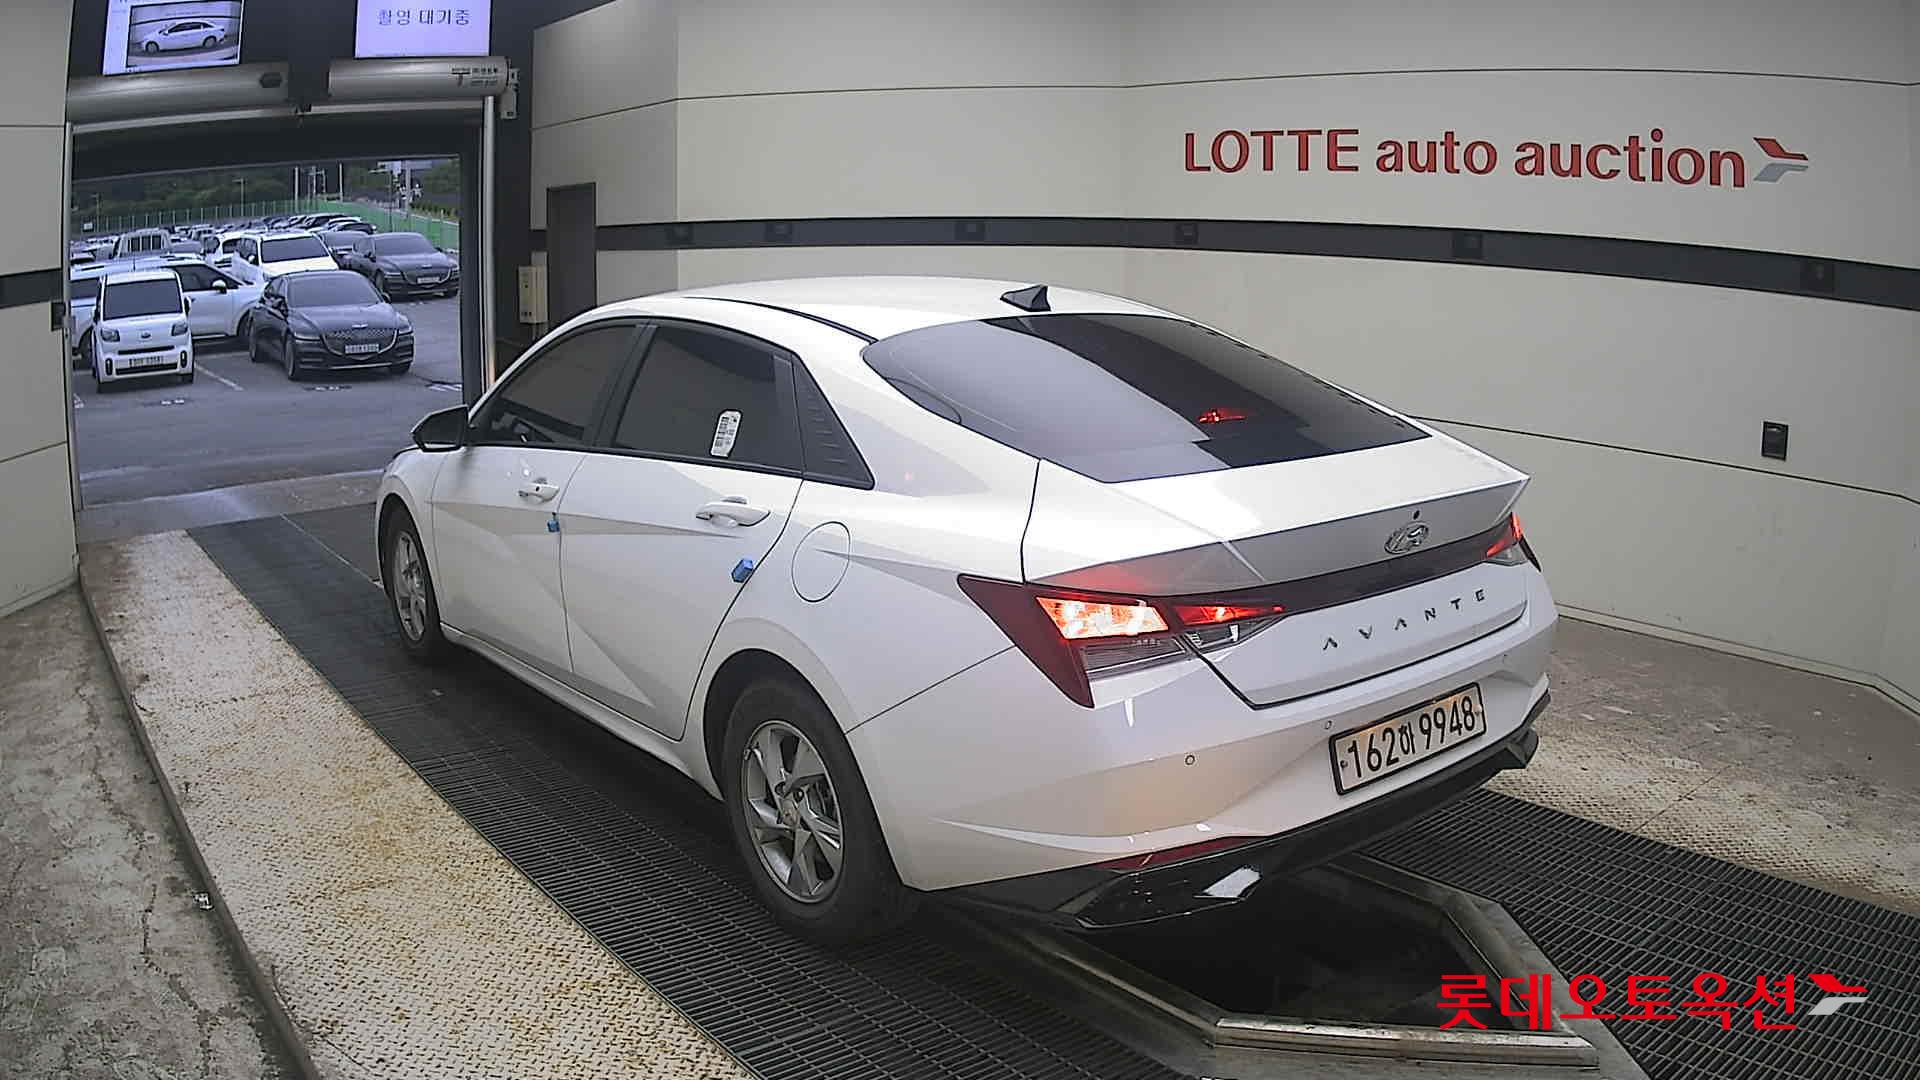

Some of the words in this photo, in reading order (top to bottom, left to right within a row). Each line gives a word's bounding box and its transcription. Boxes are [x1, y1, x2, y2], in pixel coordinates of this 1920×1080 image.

[419, 9, 471, 26] 대기중
[1184, 128, 1360, 173] LOTTE
[1376, 131, 1498, 176] auto
[1514, 128, 1746, 188] auction
[1322, 588, 1485, 651] AVANTE
